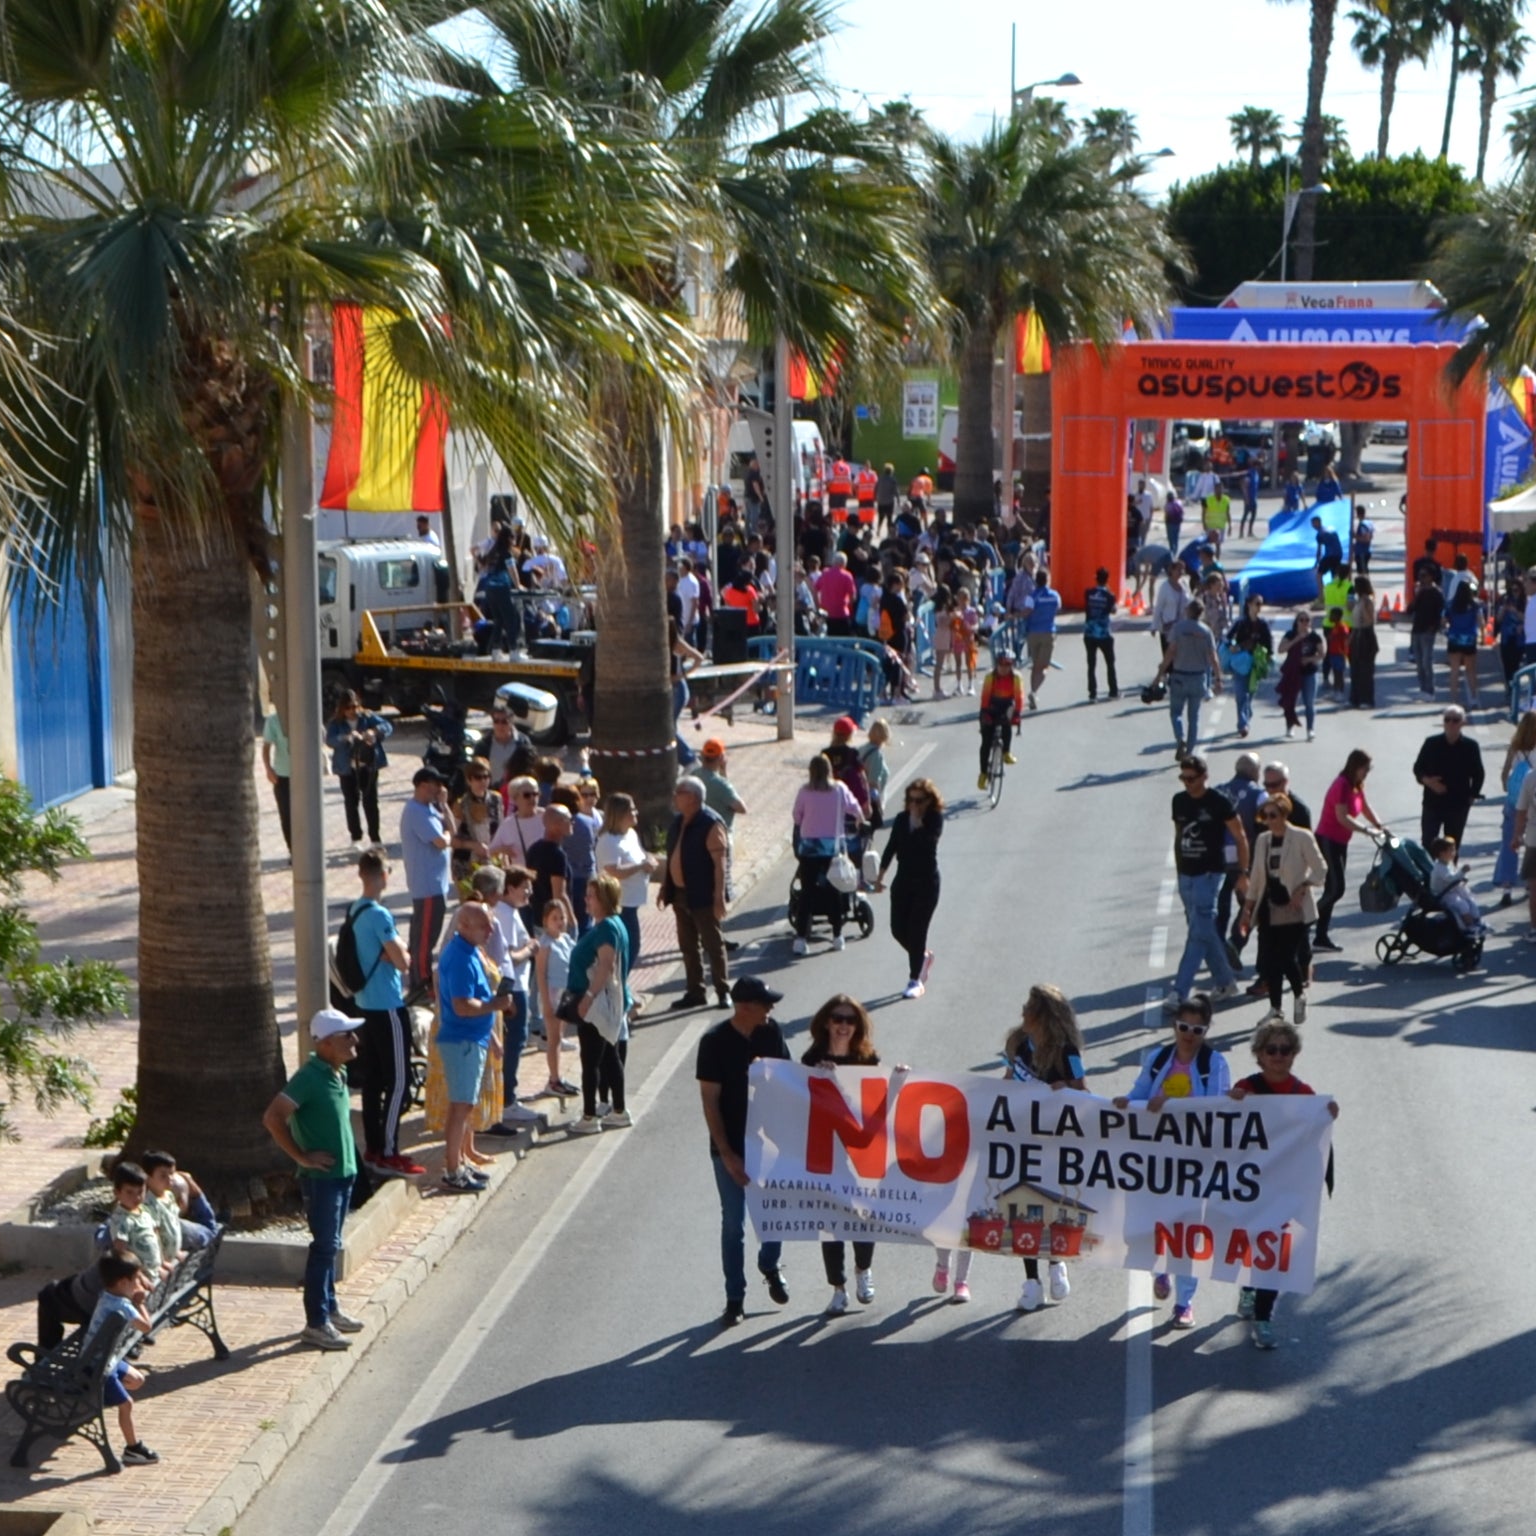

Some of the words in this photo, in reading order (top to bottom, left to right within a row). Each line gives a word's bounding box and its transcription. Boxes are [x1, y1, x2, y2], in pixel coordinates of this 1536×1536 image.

[1141, 357, 1182, 370] TIMING
[1185, 357, 1235, 370] QUALITY
[804, 1076, 970, 1184] NO
[986, 1095, 1016, 1133] A
[1030, 1101, 1084, 1139] LA
[1098, 1107, 1269, 1151] PLANTA
[986, 1141, 1044, 1184] DE
[1058, 1145, 1262, 1203] BASURAS
[762, 1199, 792, 1210] URB.
[842, 1185, 923, 1203] VISTABELLA,
[762, 1220, 825, 1232] BIGASTRO
[830, 1221, 839, 1231] Y
[1155, 1222, 1215, 1261] NO
[1224, 1223, 1293, 1273] ASÍ
